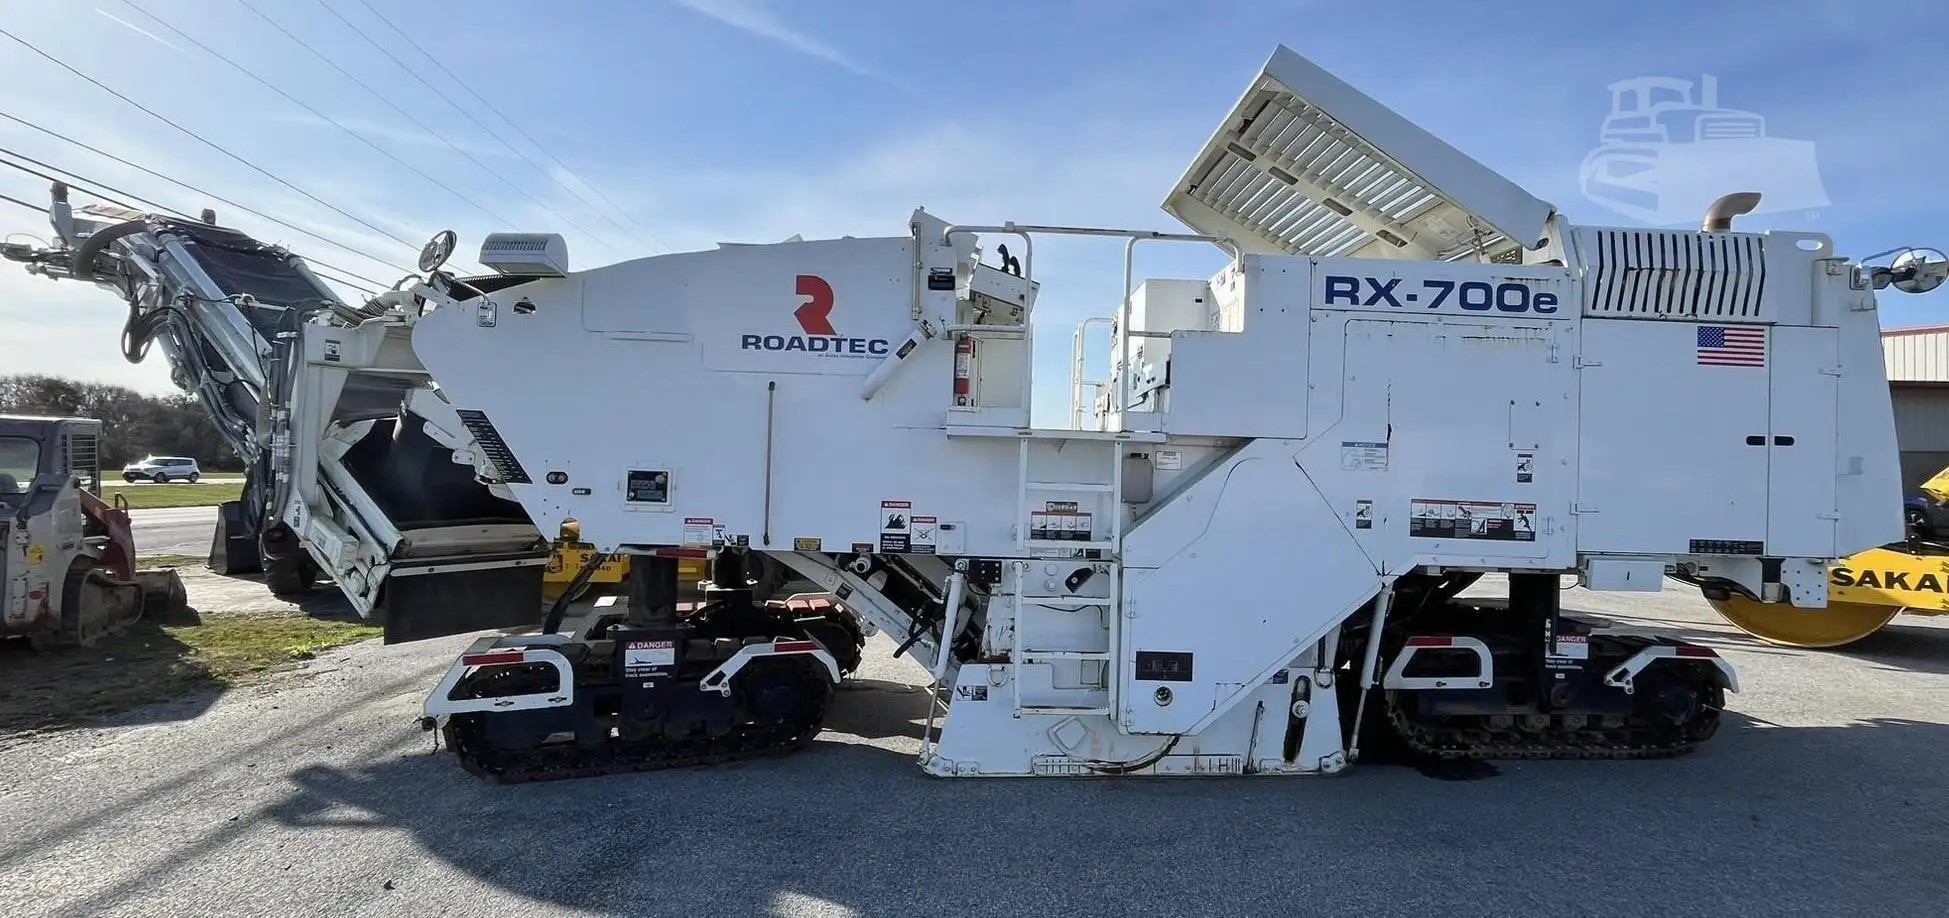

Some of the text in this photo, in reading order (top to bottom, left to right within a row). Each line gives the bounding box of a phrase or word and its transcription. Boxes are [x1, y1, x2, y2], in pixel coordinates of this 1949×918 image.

[1325, 275, 1558, 314] RX-700e
[741, 334, 889, 355] ROADTEC
[1831, 567, 1949, 594] SAKA
[637, 641, 672, 649] DANGER
